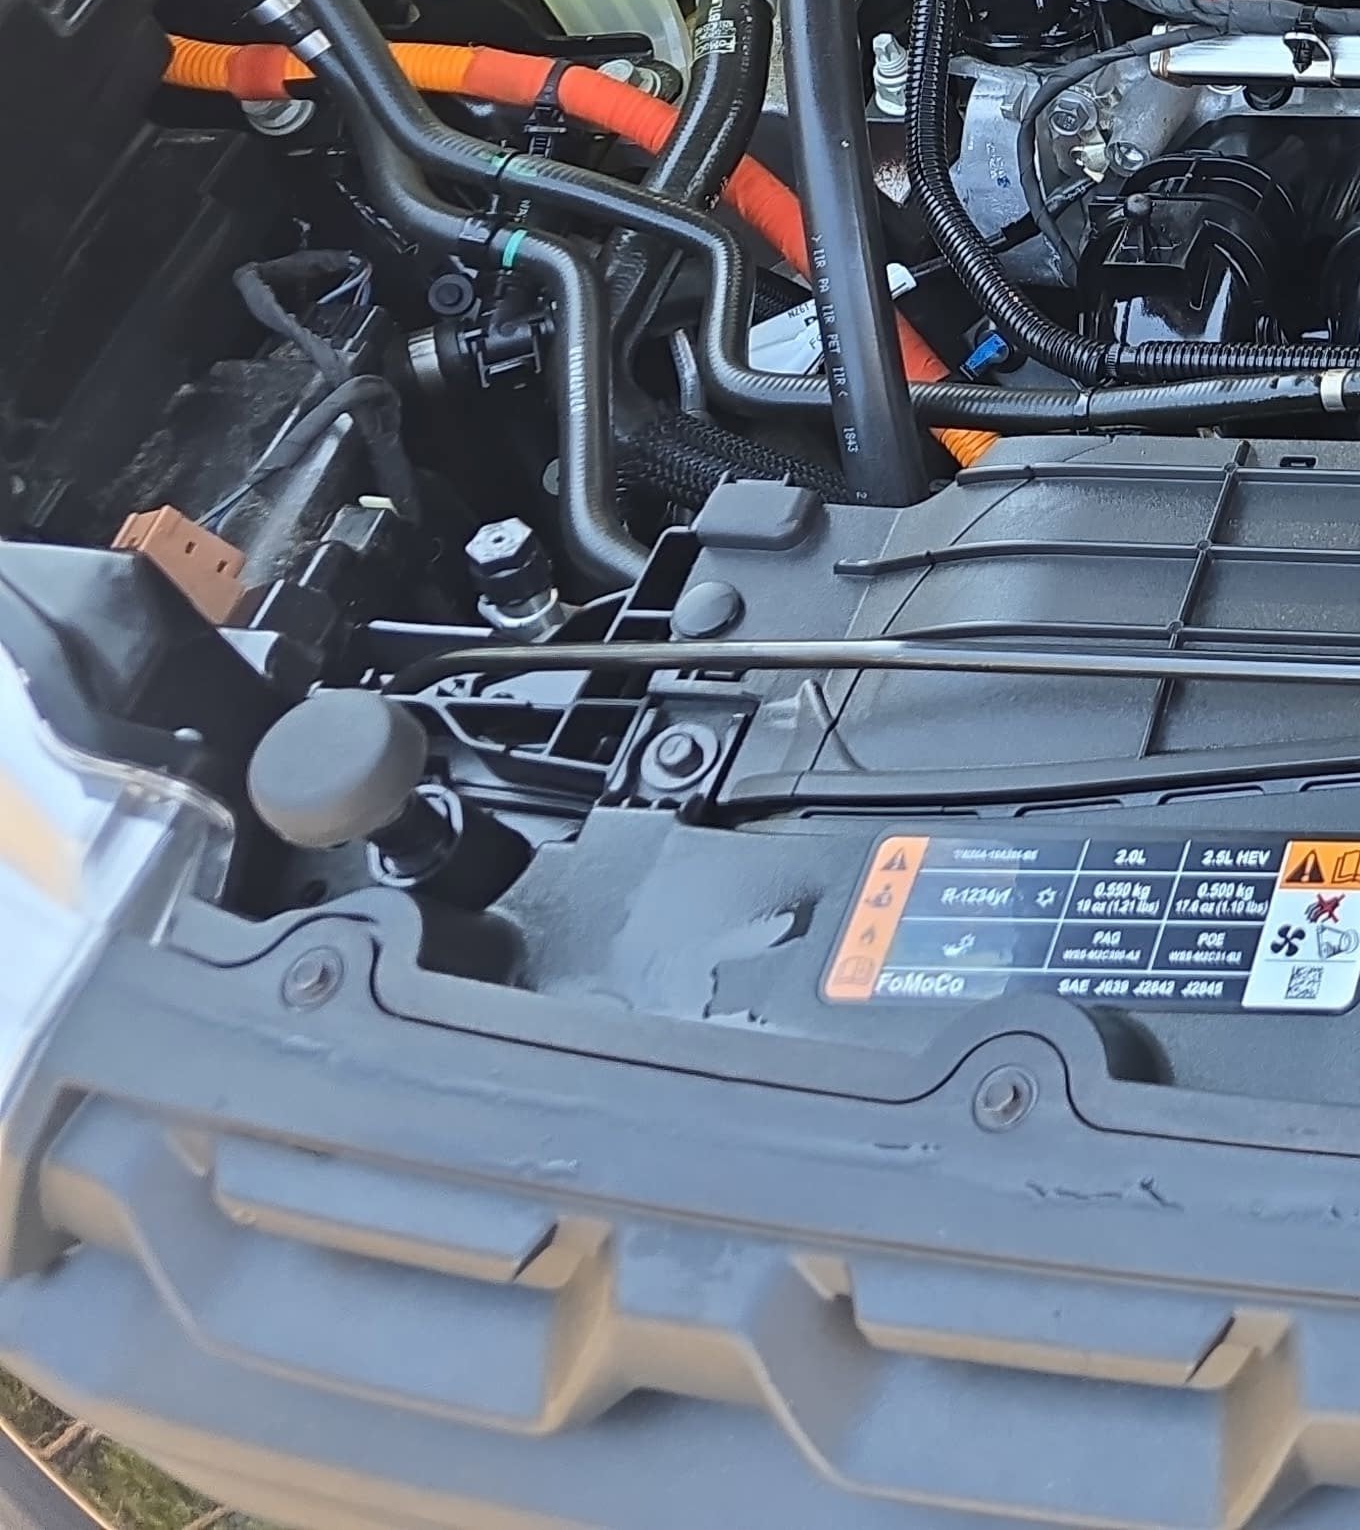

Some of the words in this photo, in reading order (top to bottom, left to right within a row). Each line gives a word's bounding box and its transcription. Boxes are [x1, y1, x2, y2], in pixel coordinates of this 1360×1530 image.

[1114, 849, 1147, 865] 2.0L
[1235, 850, 1271, 866] HEV
[1132, 881, 1152, 901] kg
[1235, 882, 1255, 901] kg
[1196, 931, 1226, 949] POE
[875, 972, 966, 996] FoMoCo
[1057, 978, 1091, 996] SAE
